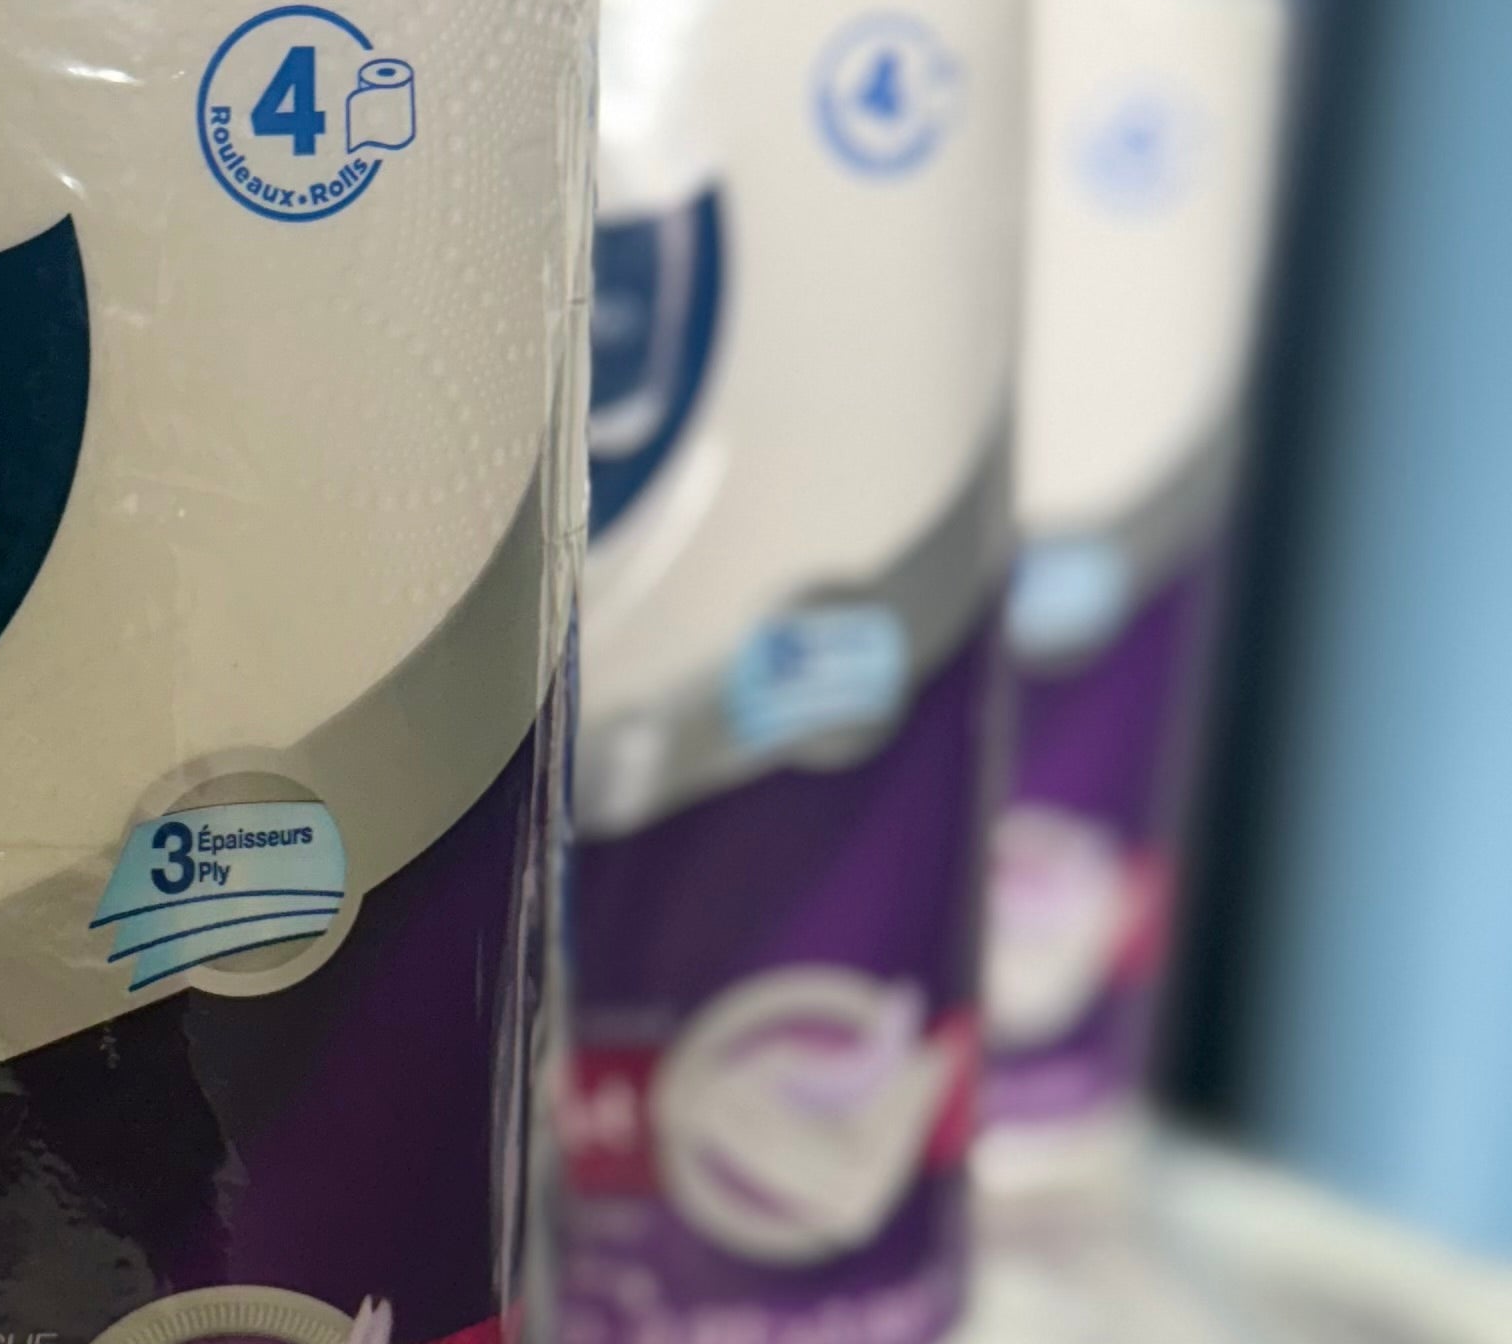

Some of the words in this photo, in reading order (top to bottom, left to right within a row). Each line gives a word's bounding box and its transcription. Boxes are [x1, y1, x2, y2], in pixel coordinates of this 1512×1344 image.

[250, 45, 326, 156] 4
[150, 821, 196, 895] 3
[197, 824, 313, 855] Épaisseurs
[198, 861, 231, 886] Ply
